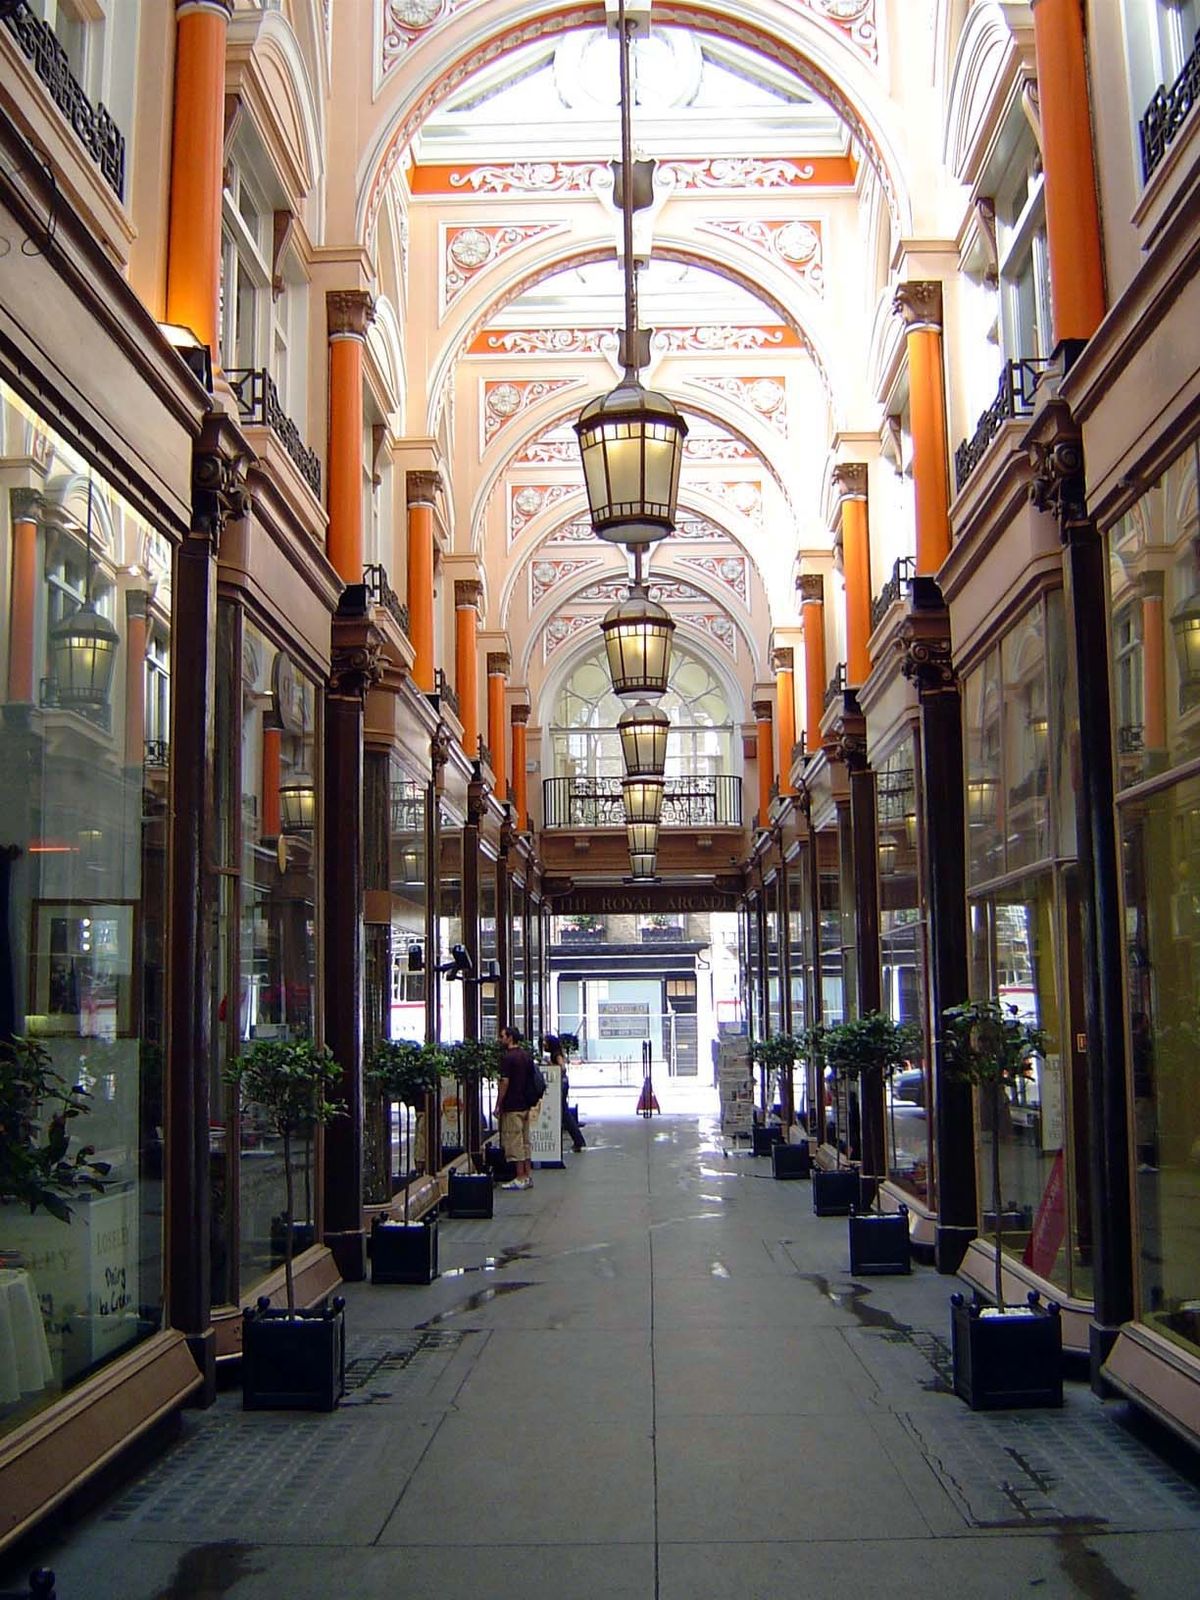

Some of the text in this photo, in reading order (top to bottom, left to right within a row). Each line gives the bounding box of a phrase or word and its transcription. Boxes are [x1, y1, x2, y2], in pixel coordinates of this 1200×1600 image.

[558, 894, 729, 911] THE ROYAL ARCADE
[530, 1130, 554, 1141] STUME
